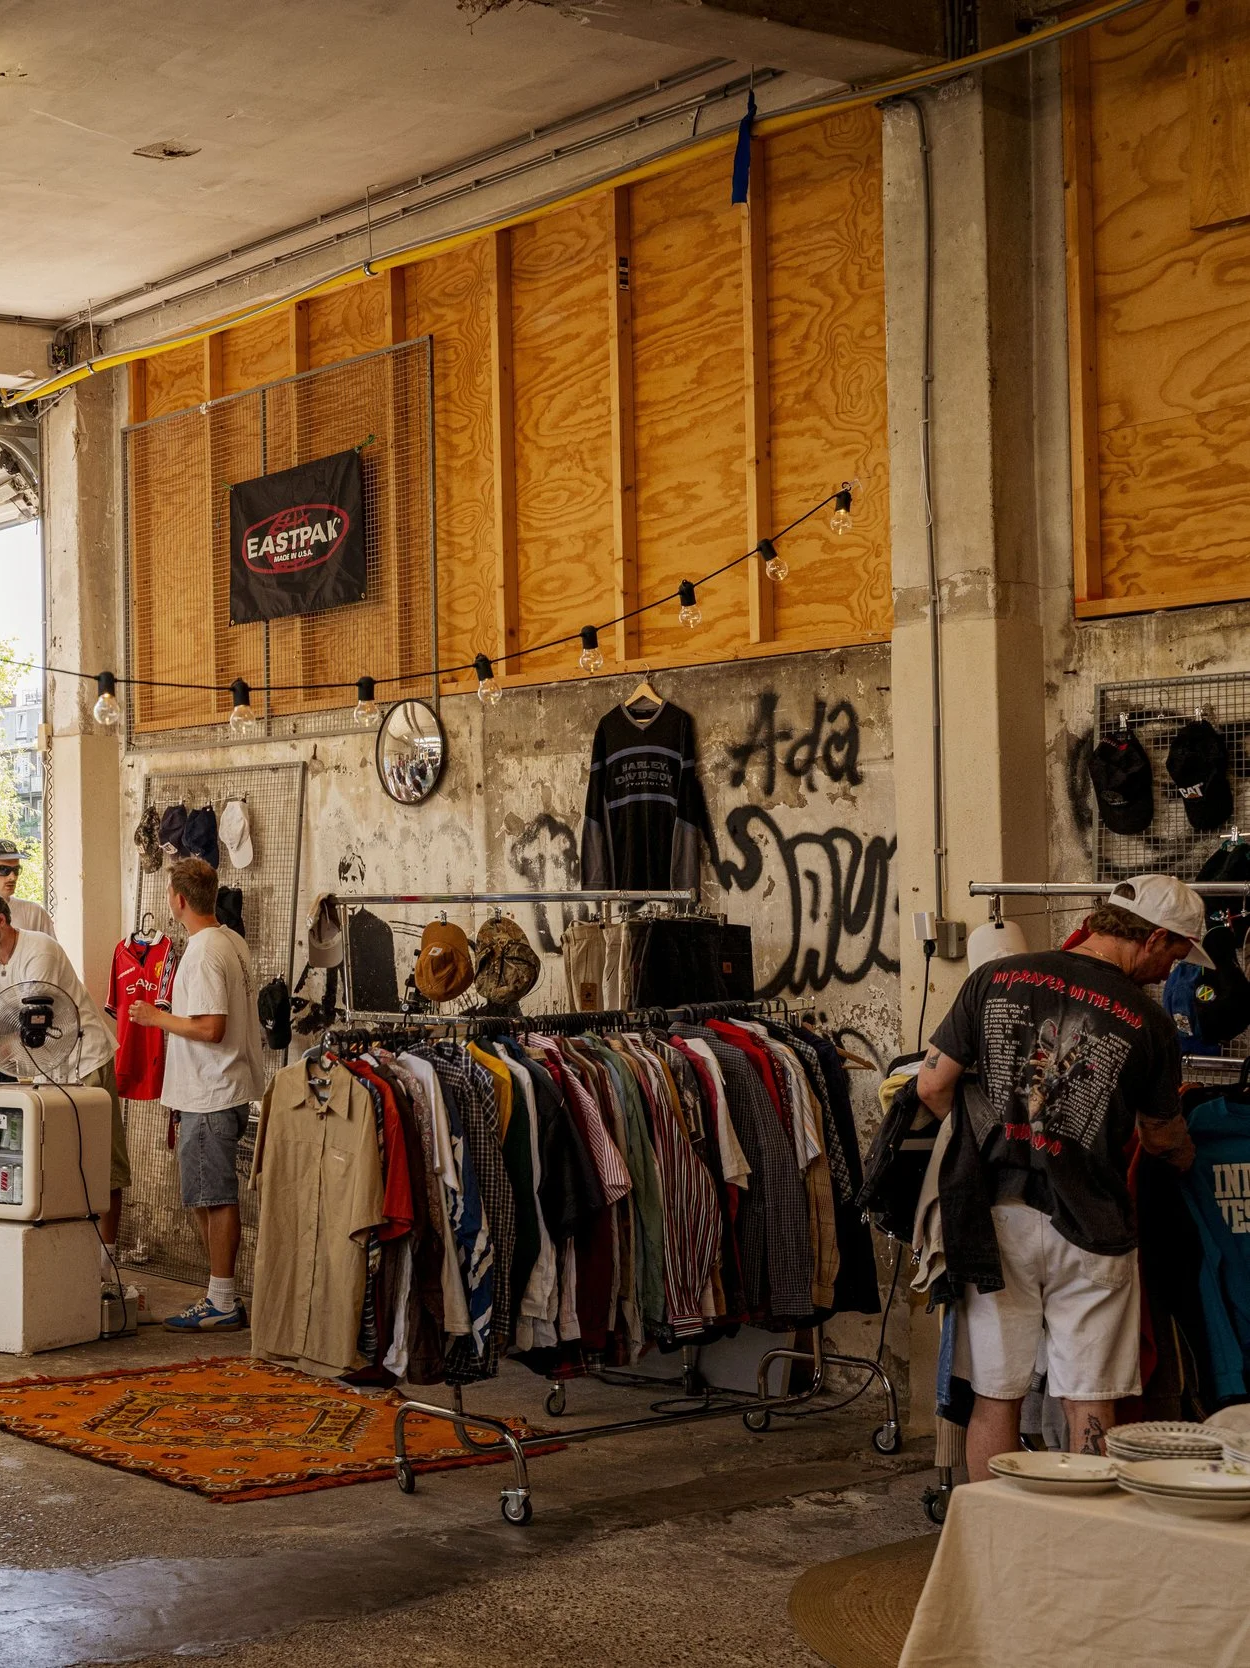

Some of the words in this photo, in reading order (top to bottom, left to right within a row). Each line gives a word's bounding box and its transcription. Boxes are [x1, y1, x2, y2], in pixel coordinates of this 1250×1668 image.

[247, 518, 339, 559] EASTPAK
[273, 553, 290, 563] MADE
[290, 552, 297, 560] IN
[1178, 783, 1203, 799] CAT
[1087, 989, 1111, 1011] THE
